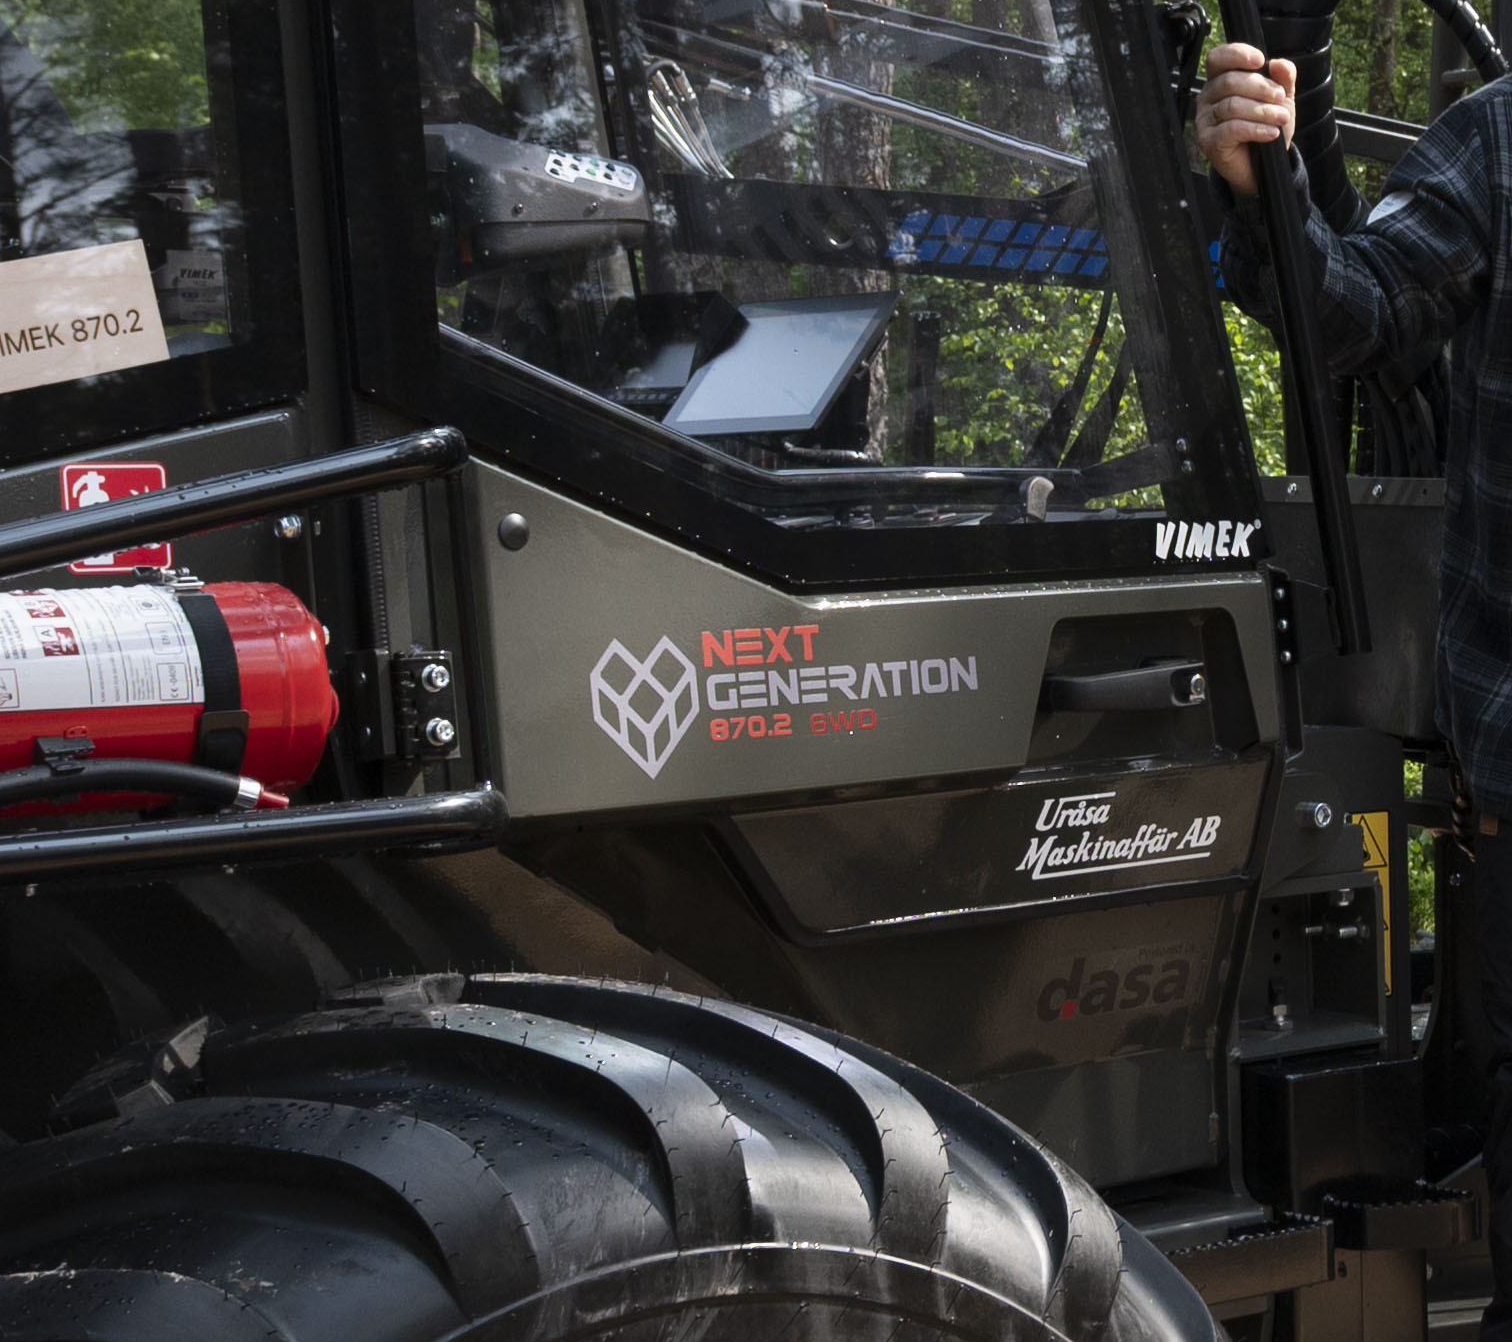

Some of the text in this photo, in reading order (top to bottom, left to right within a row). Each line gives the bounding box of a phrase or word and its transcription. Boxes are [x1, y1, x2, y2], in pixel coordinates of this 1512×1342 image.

[71, 309, 144, 343] 870.2
[701, 624, 820, 668] NEXT
[706, 656, 979, 711] GENERATION
[709, 709, 877, 742] 870.2 6WD
[1035, 793, 1115, 832] Uråsa
[1015, 815, 1222, 879] Maskinaffär AB
[1038, 957, 1190, 1023] dasa
